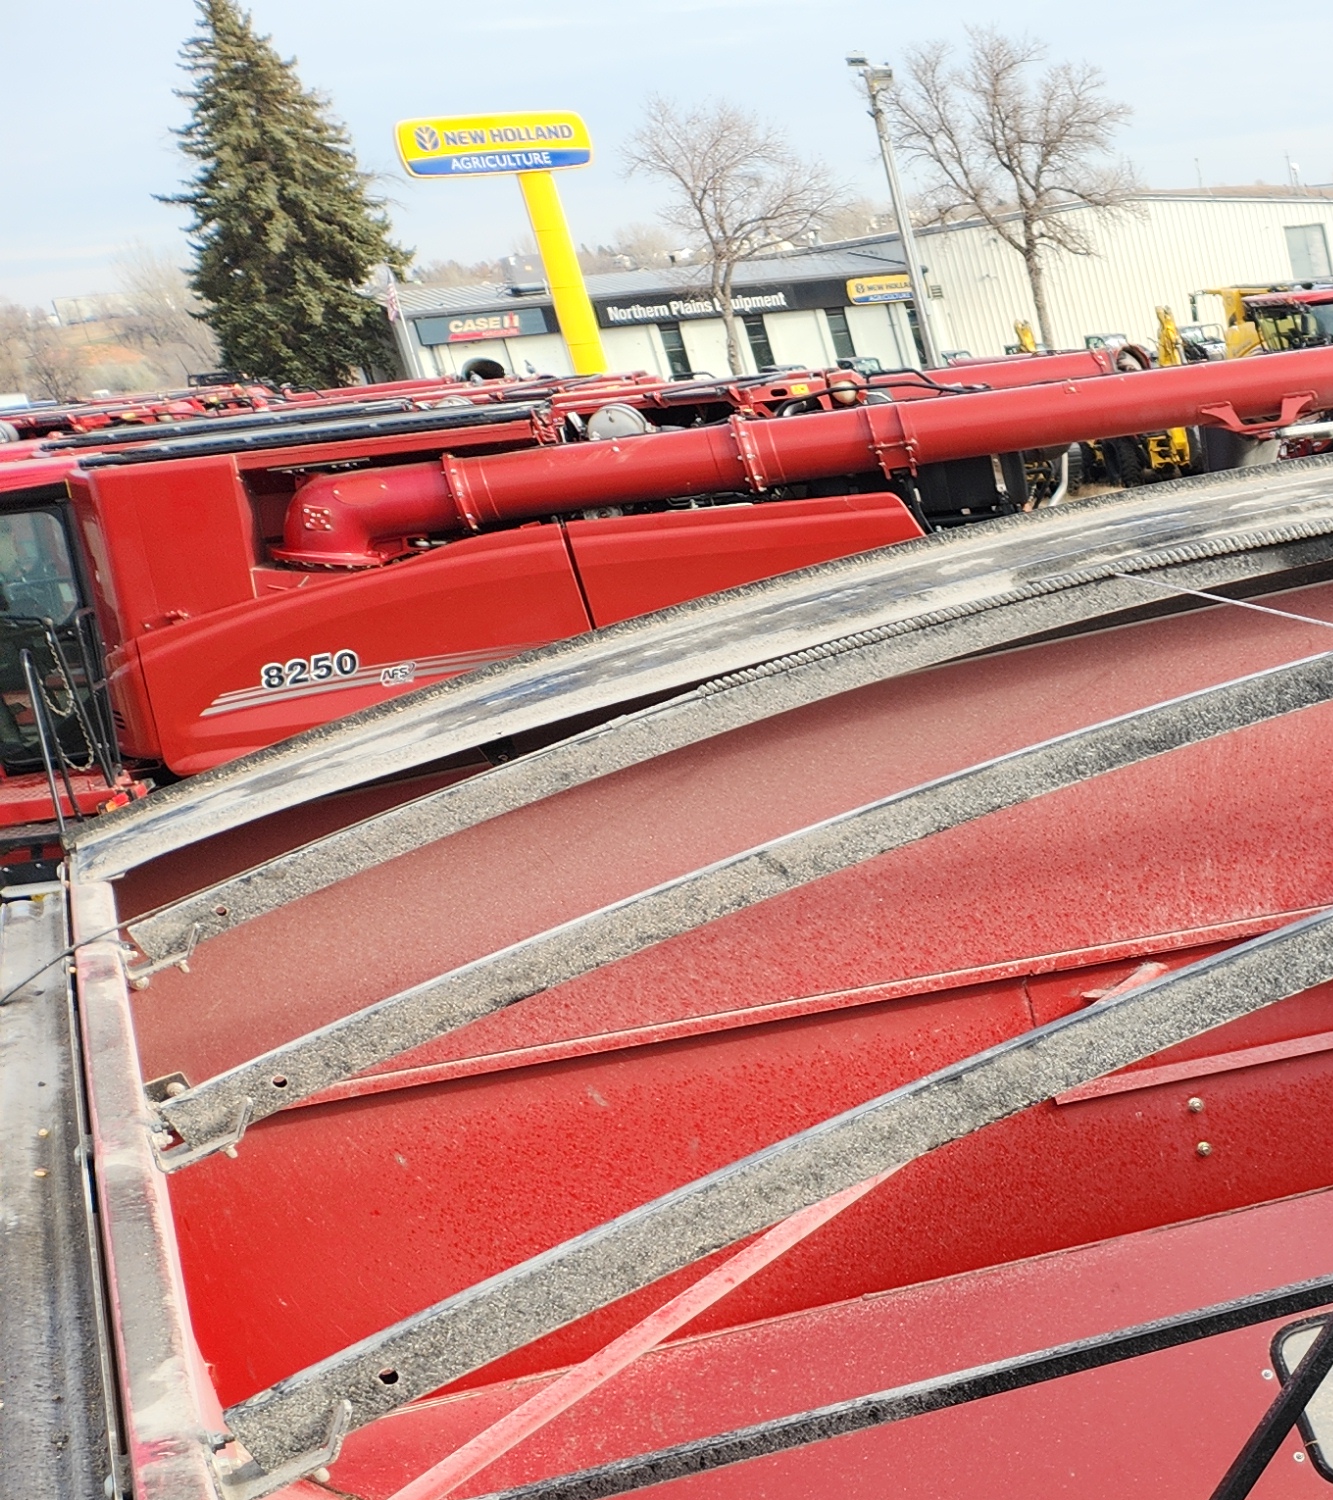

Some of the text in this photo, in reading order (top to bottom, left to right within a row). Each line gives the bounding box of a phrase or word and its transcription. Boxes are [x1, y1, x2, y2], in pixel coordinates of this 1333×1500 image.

[443, 124, 573, 146] NEW HOLLAND
[451, 152, 552, 170] AGRICULTURE
[606, 303, 669, 322] Northern
[669, 299, 713, 316] Plains
[449, 316, 501, 333] CASE
[260, 649, 359, 689] 8250
